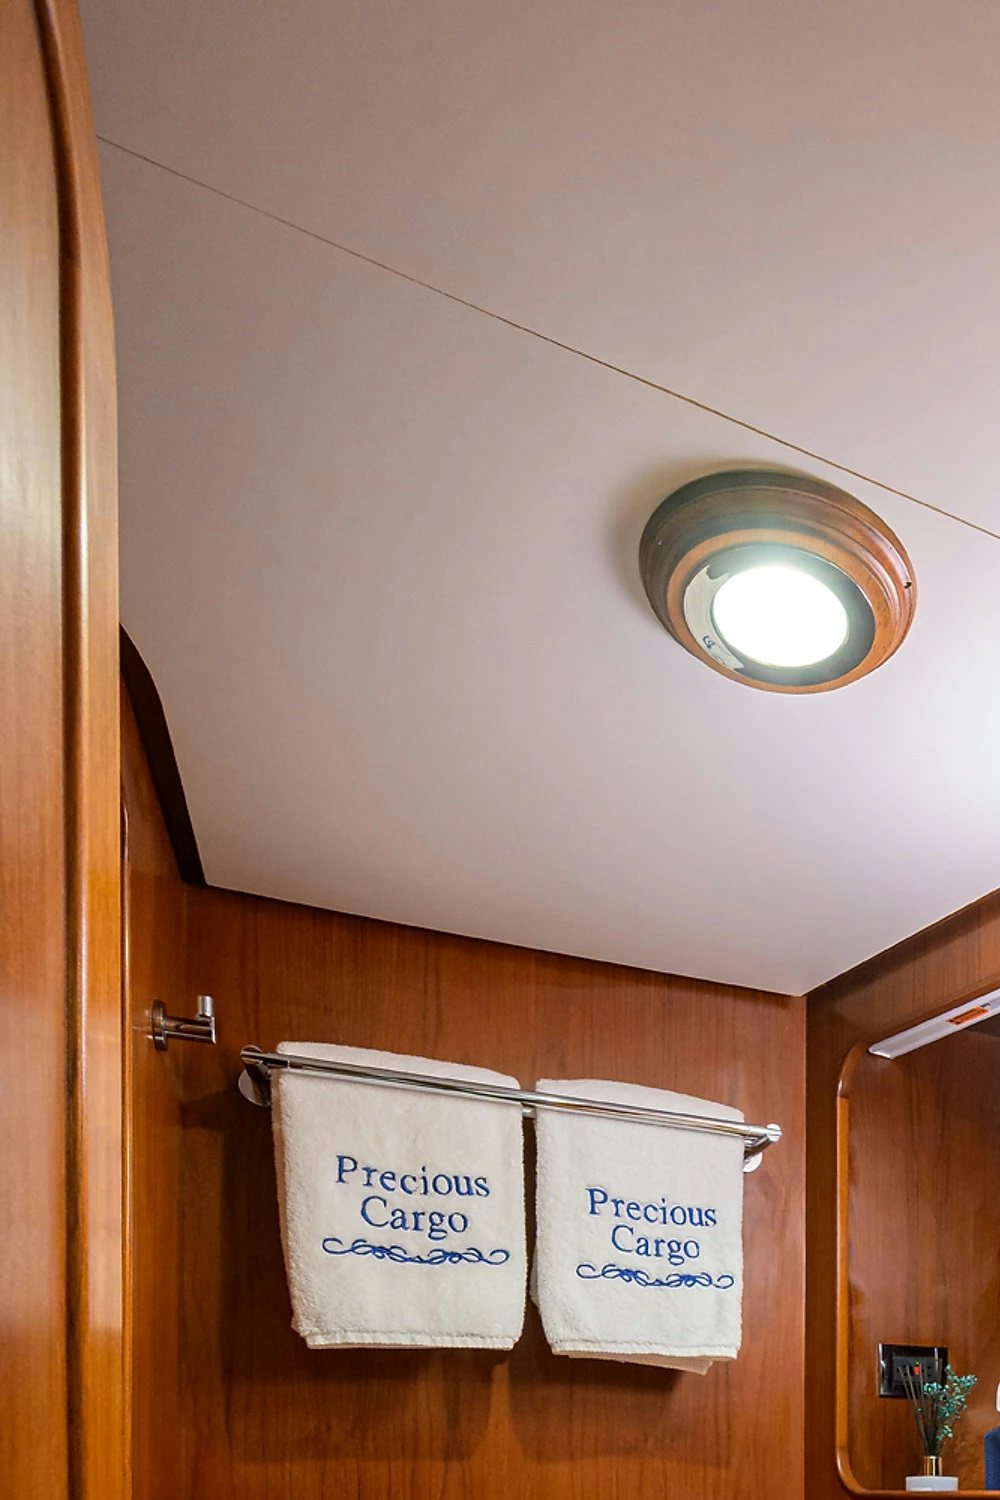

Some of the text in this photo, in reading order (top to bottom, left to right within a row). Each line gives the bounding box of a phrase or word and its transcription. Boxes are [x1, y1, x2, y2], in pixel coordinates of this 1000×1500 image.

[336, 1155, 491, 1198] Precious
[360, 1196, 470, 1241] Cargo
[586, 1187, 718, 1228] Precious
[610, 1224, 702, 1267] Cargo
